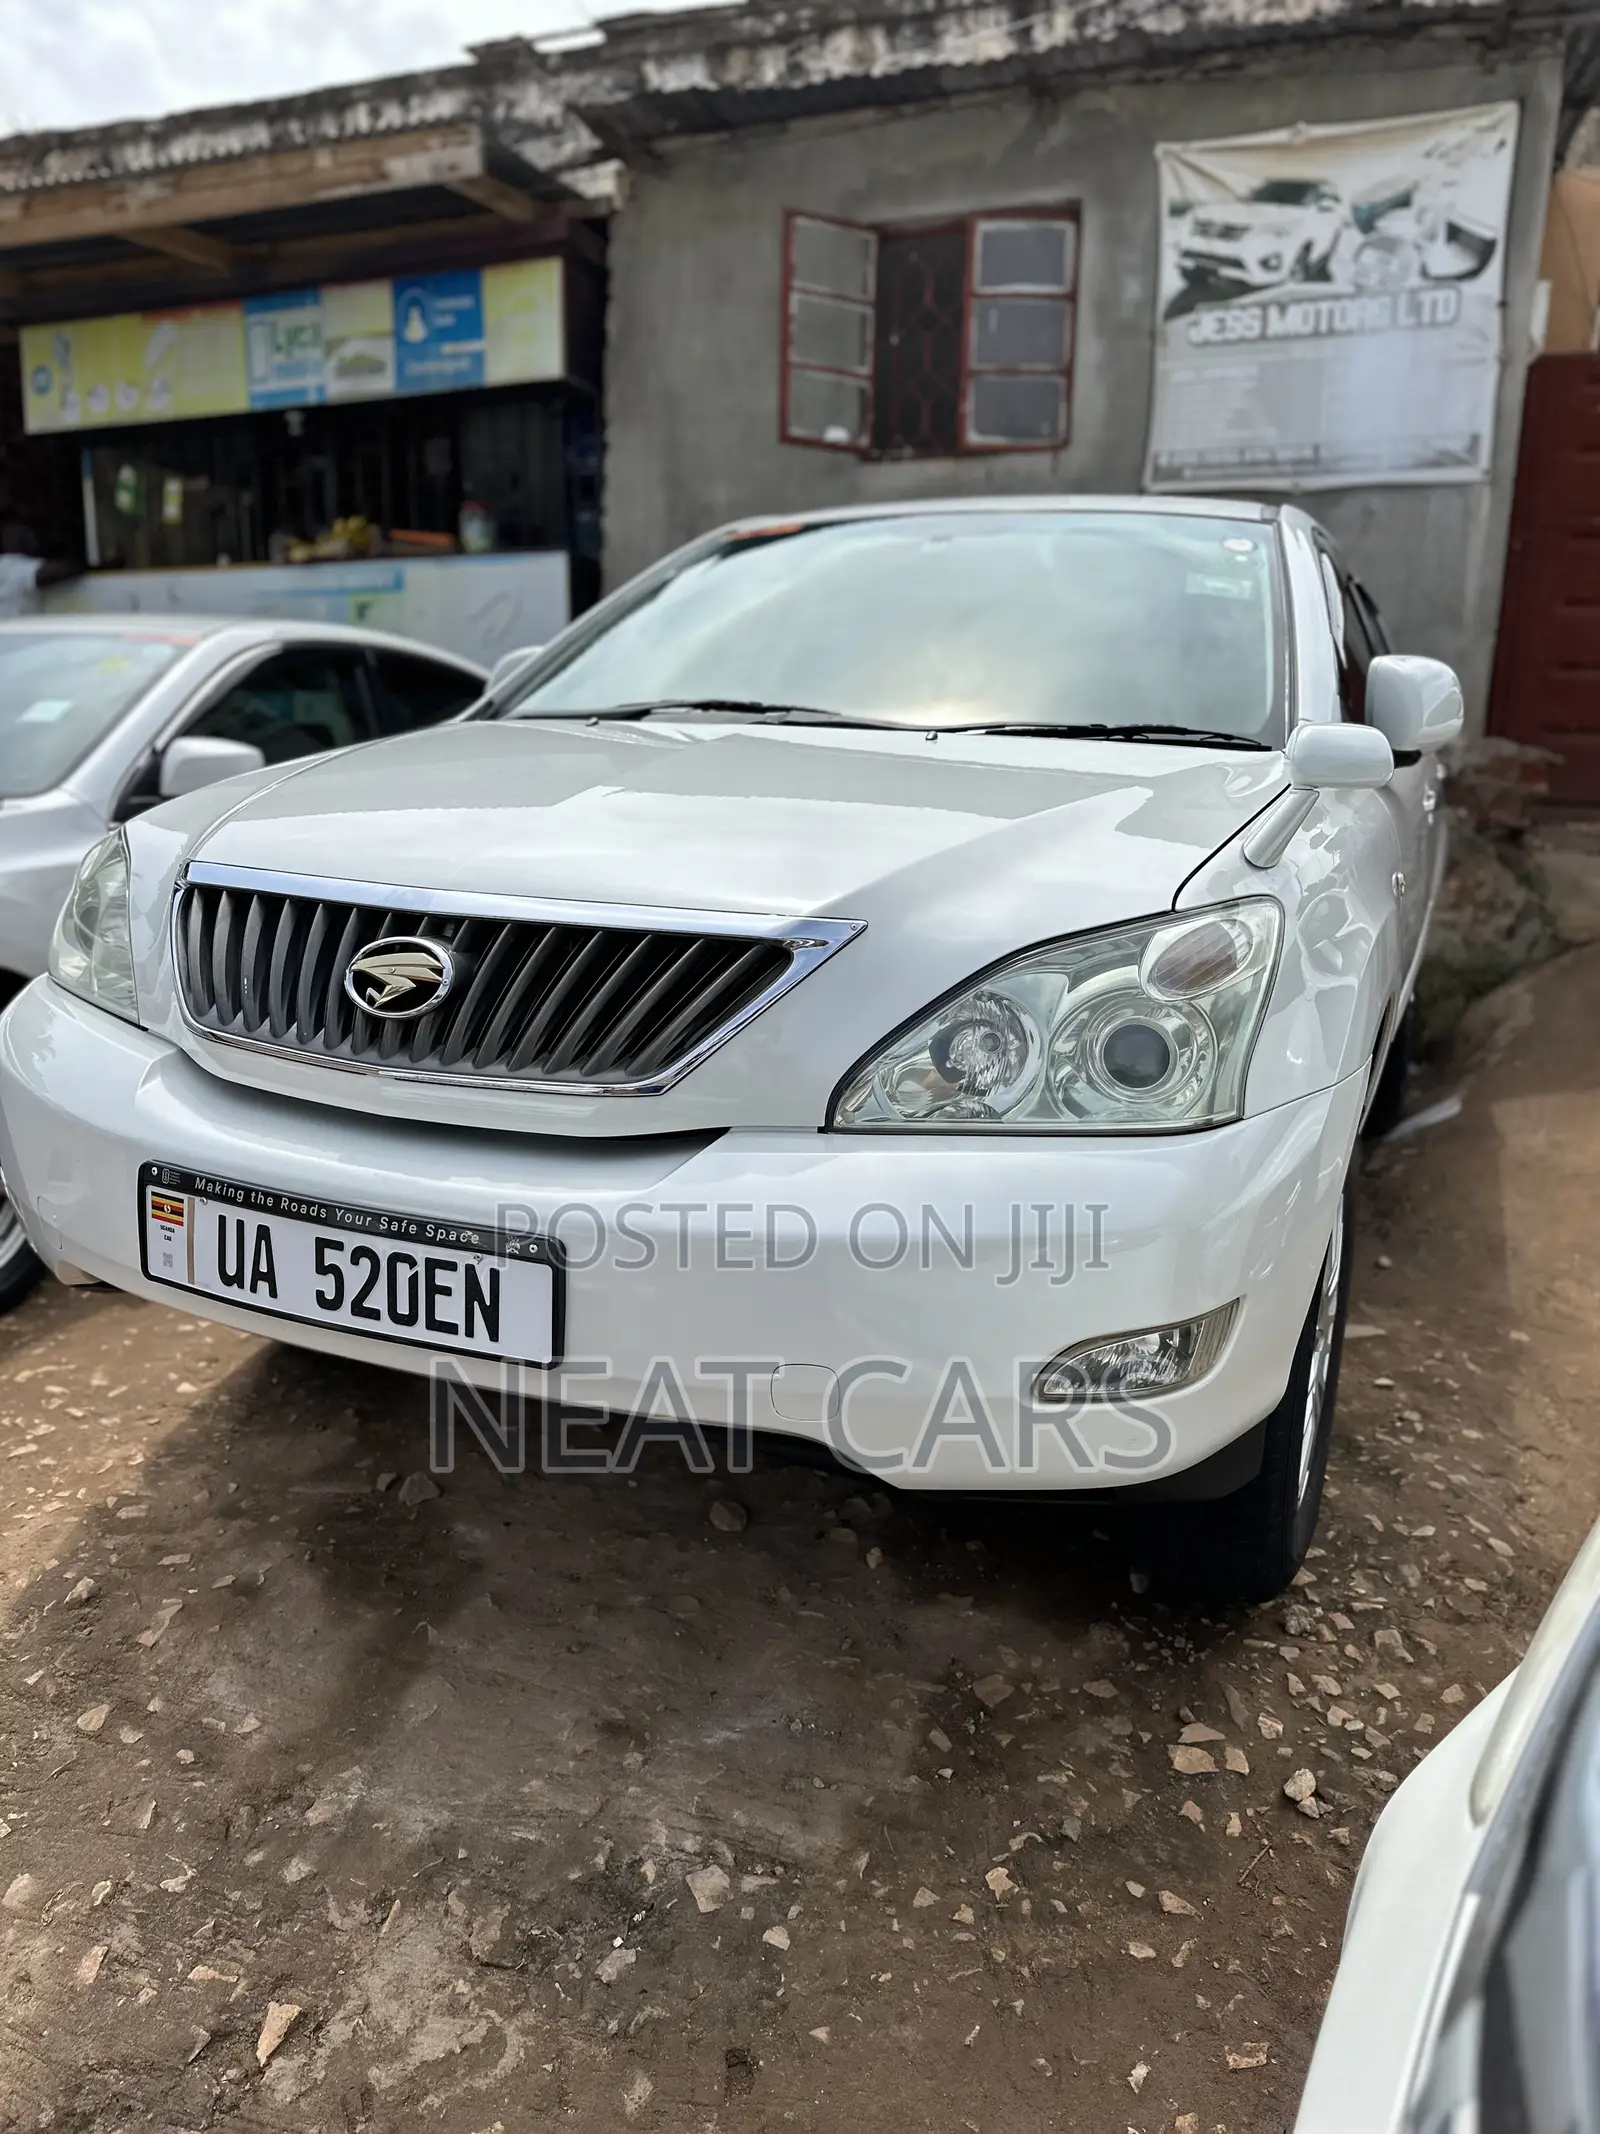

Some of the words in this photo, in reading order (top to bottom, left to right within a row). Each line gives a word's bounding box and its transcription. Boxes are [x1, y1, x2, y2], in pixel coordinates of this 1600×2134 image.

[1188, 307, 1264, 346] JESS
[1266, 296, 1393, 339] MOTORS
[1398, 287, 1460, 327] LTD
[194, 1176, 246, 1203] Making
[250, 1191, 275, 1208] the
[280, 1196, 328, 1219] Roads
[334, 1207, 373, 1228] Your
[378, 1215, 418, 1236] Safe
[424, 1223, 481, 1246] Space
[217, 1213, 279, 1300] UA
[314, 1235, 501, 1343] 520EN
